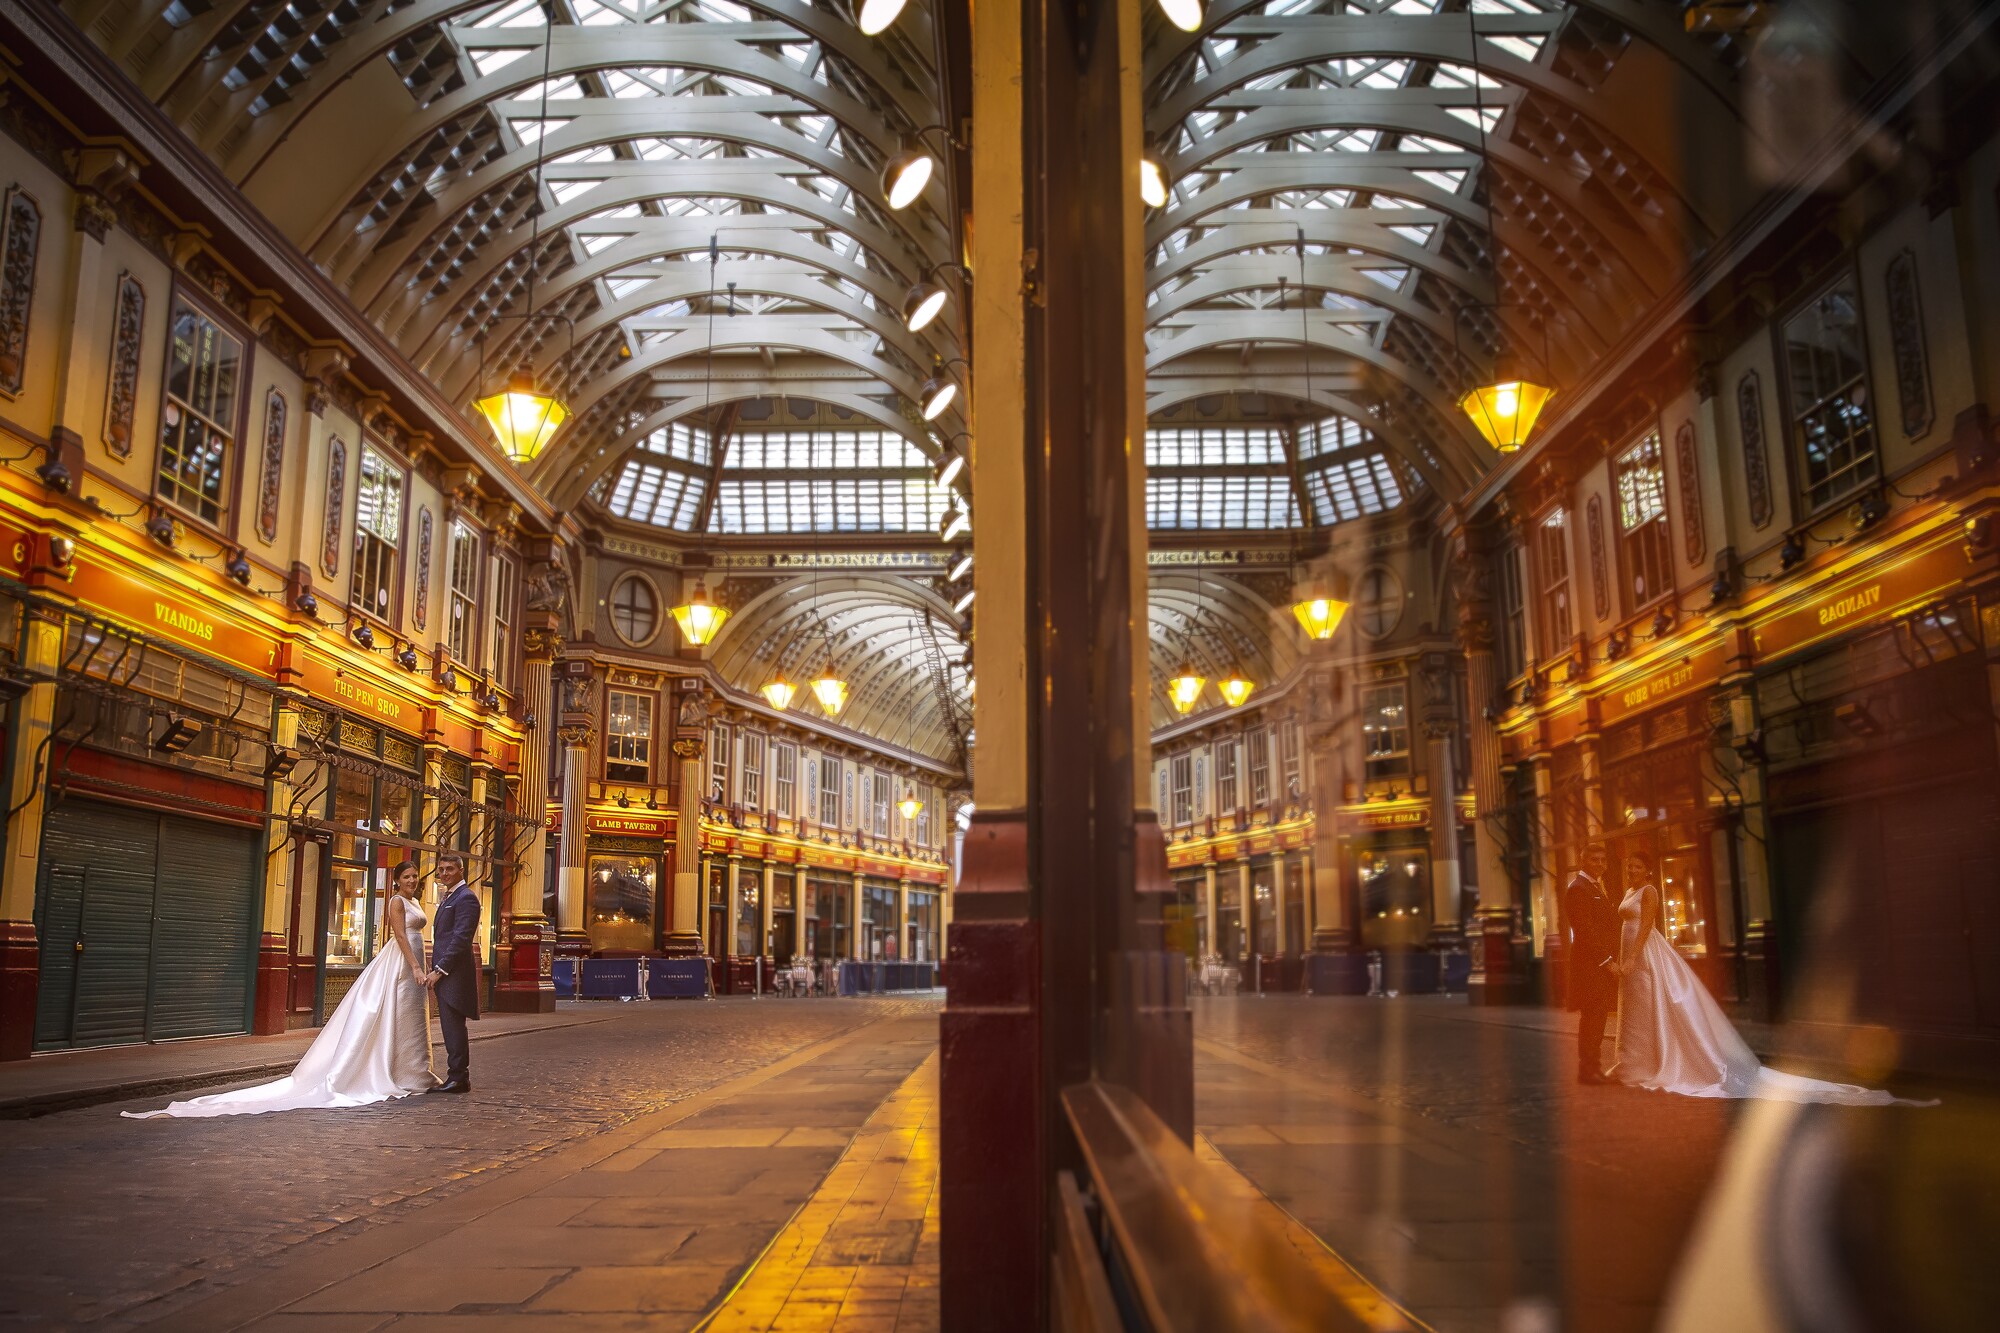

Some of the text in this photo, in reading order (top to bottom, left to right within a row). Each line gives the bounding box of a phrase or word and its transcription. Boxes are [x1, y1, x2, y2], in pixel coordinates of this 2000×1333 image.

[13, 542, 25, 563] 6
[774, 553, 925, 567] LEADENHALL
[67, 564, 77, 583] 7
[155, 602, 213, 640] VIANDAS
[268, 649, 276, 666] 7
[334, 678, 400, 718] THE PEN SHOP
[596, 819, 657, 831] LAMB TAVERN
[712, 838, 726, 847] LAMB
